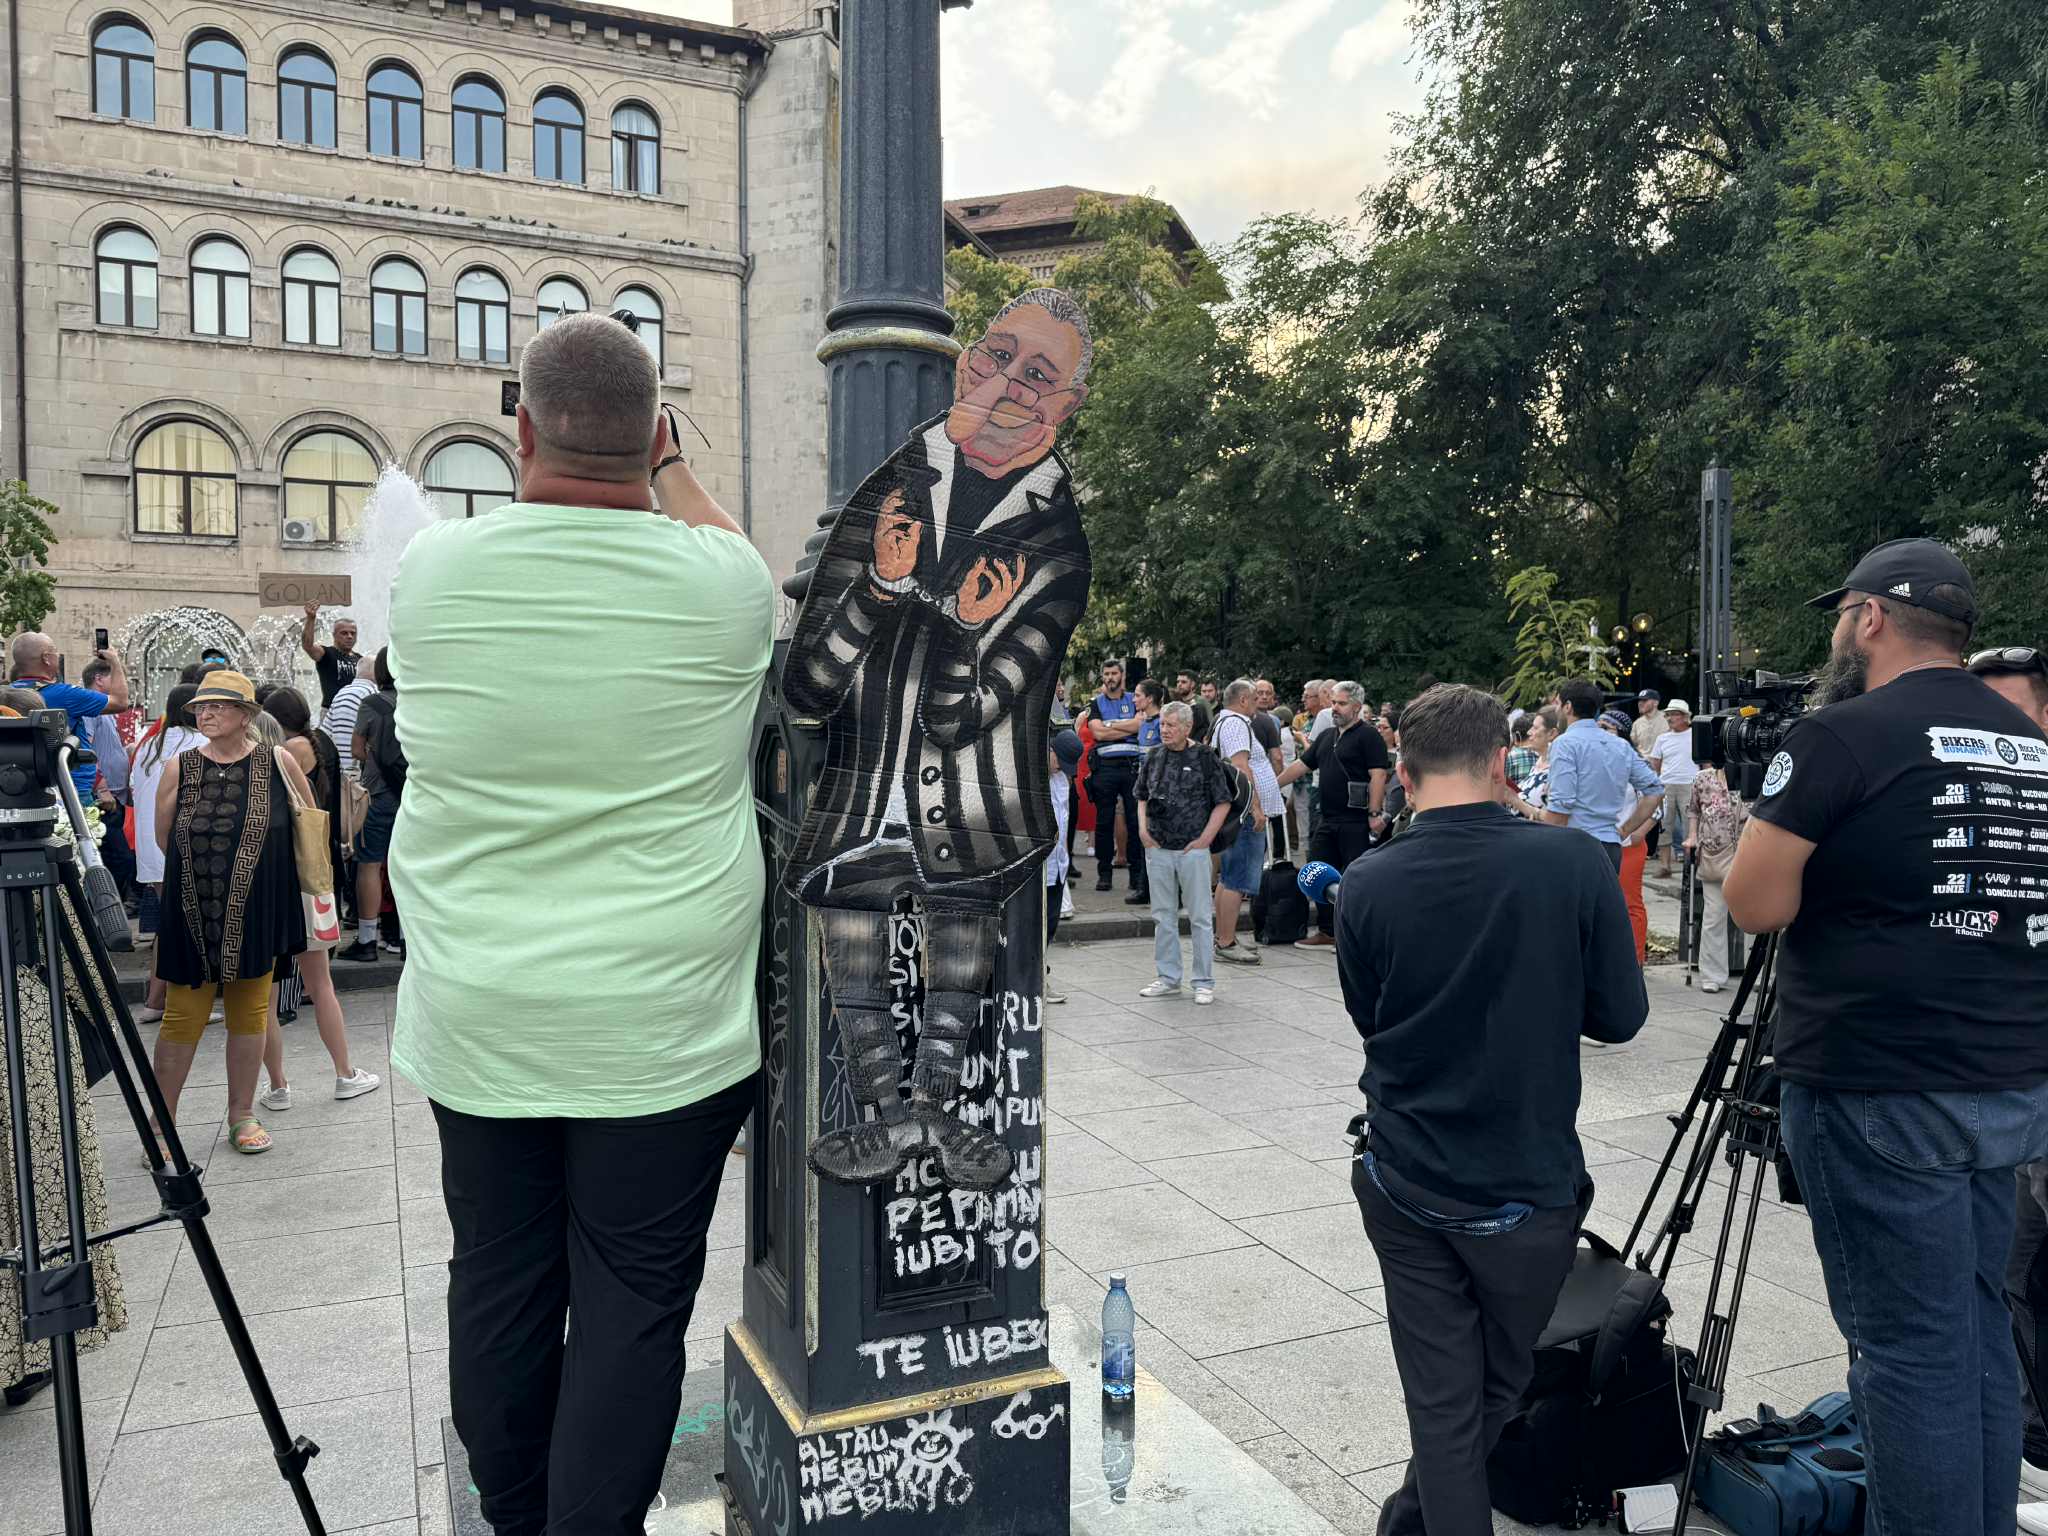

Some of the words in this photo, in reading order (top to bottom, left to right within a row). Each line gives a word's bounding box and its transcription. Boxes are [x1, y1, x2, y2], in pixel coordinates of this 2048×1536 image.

[263, 583, 346, 602] GOLAN
[1940, 736, 1986, 749] BIKERS
[1945, 783, 1964, 796] 20
[1932, 795, 1966, 806] IUNIE
[1985, 797, 2012, 808] ANTON
[1946, 827, 1965, 839] 21
[1988, 826, 2024, 838] HOLOGRAF
[1932, 838, 1968, 848] IUNIE
[1988, 839, 2022, 851] BOSQUITO
[1946, 873, 1966, 885] 22
[1932, 884, 1965, 895] IUNIE
[1930, 909, 1993, 933] ROCK
[884, 1192, 946, 1241] PE
[856, 1335, 927, 1379] TE
